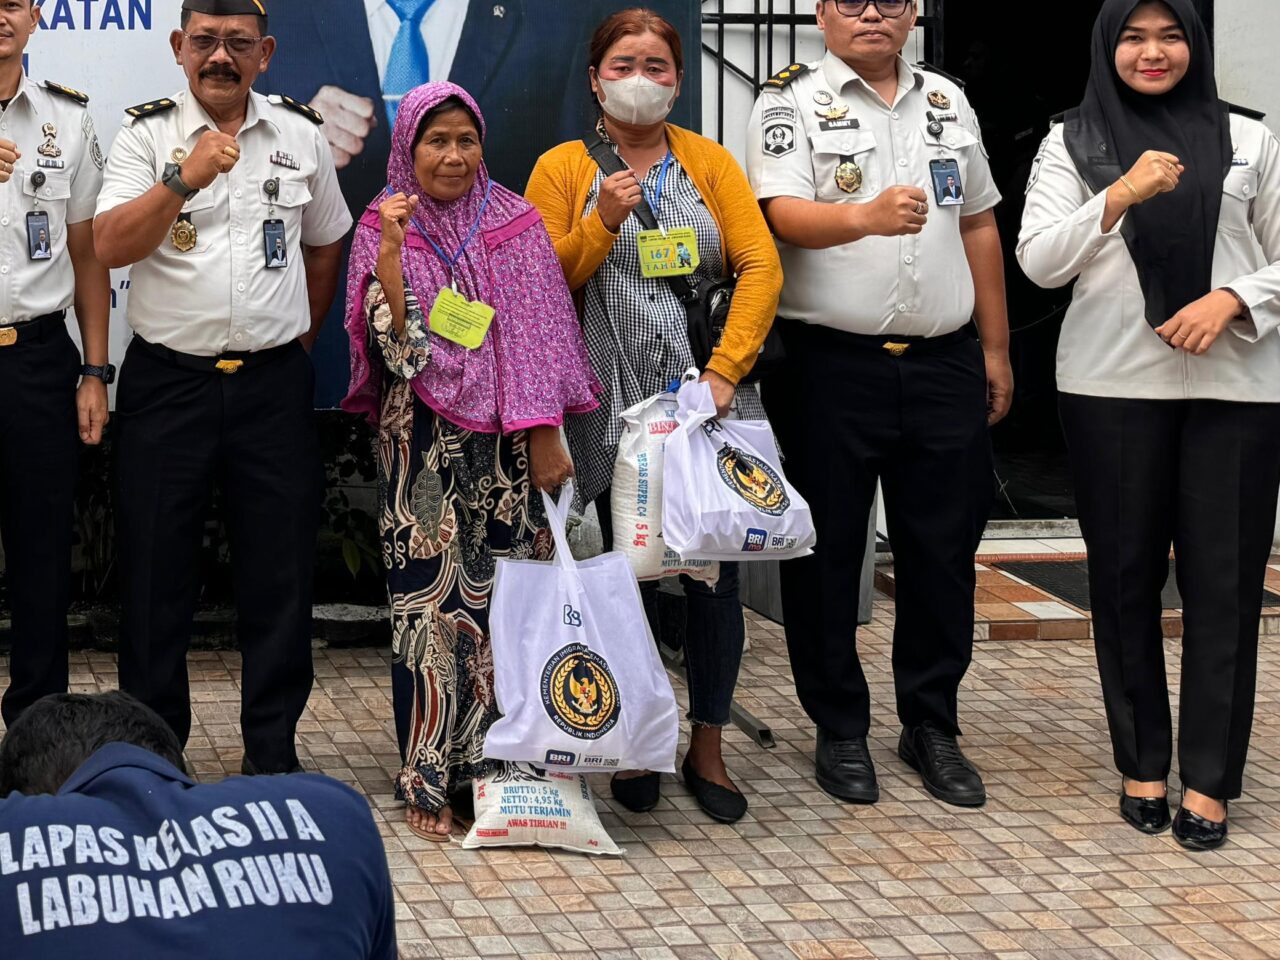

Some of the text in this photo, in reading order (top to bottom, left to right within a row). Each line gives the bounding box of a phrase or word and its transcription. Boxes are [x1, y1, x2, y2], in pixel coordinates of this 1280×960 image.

[650, 248, 670, 260] 167
[748, 533, 764, 544] BRI
[771, 537, 785, 547] BRI
[542, 656, 560, 705] KEMENTERIAN
[553, 715, 615, 739] REPUBLIK INDONESIA
[549, 753, 571, 762] BRI
[503, 785, 536, 795] BRUTTO
[501, 795, 528, 804] NETTO
[499, 805, 572, 817] MUTU TERJAMIN
[506, 819, 528, 828] AWAS
[529, 819, 559, 829] TIRUAN
[132, 806, 253, 872] KELAS
[17, 852, 333, 935] LABUHAN RUKU
